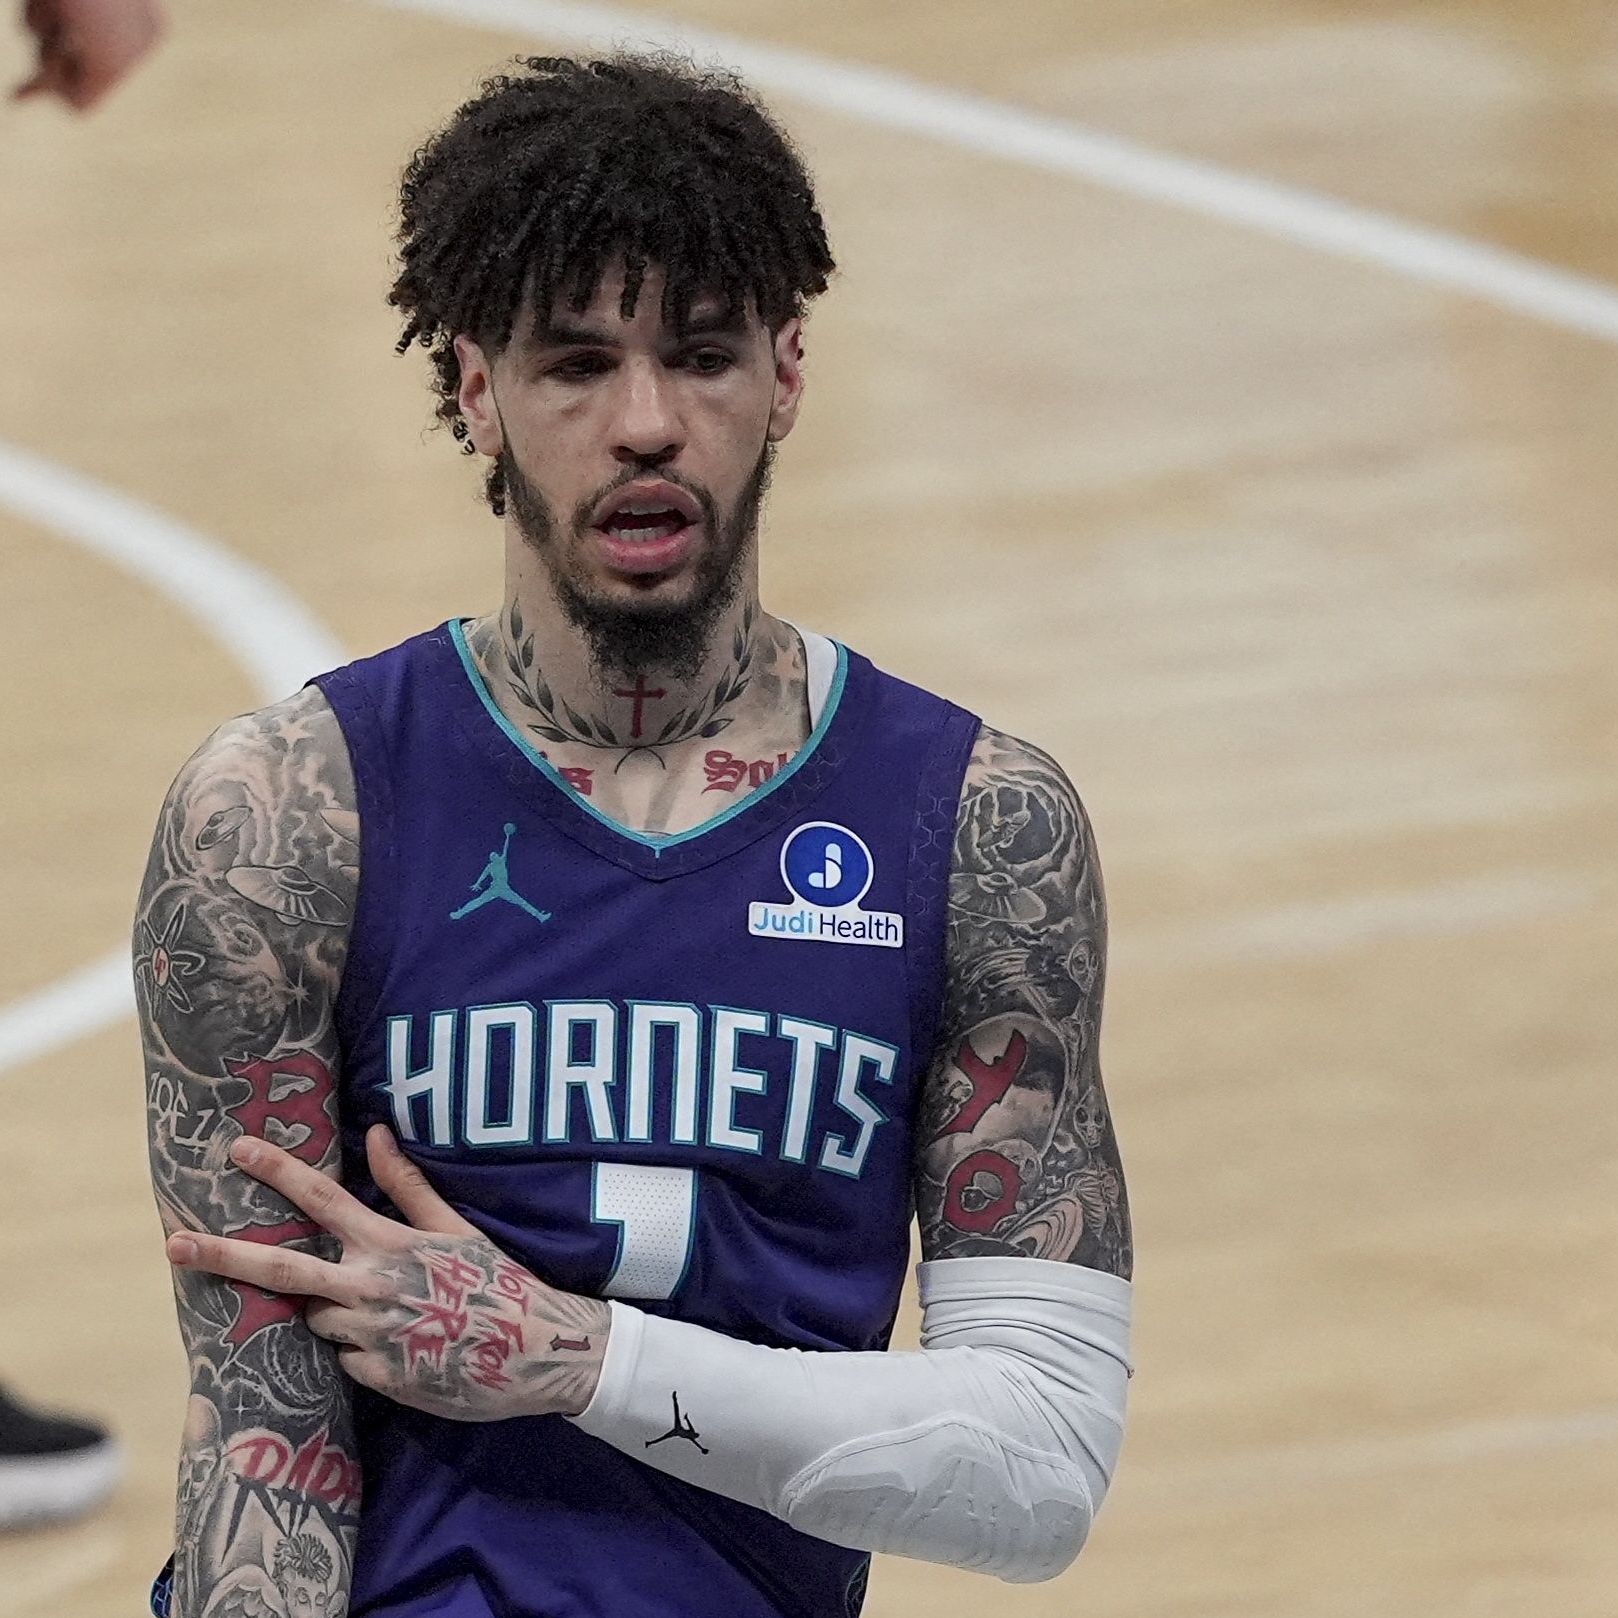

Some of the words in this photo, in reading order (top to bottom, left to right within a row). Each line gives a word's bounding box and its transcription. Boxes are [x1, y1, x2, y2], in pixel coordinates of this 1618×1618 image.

[754, 906, 814, 934] Judi
[819, 912, 899, 942] Health
[375, 999, 901, 1180] HORNETS
[590, 1160, 697, 1300] 1
